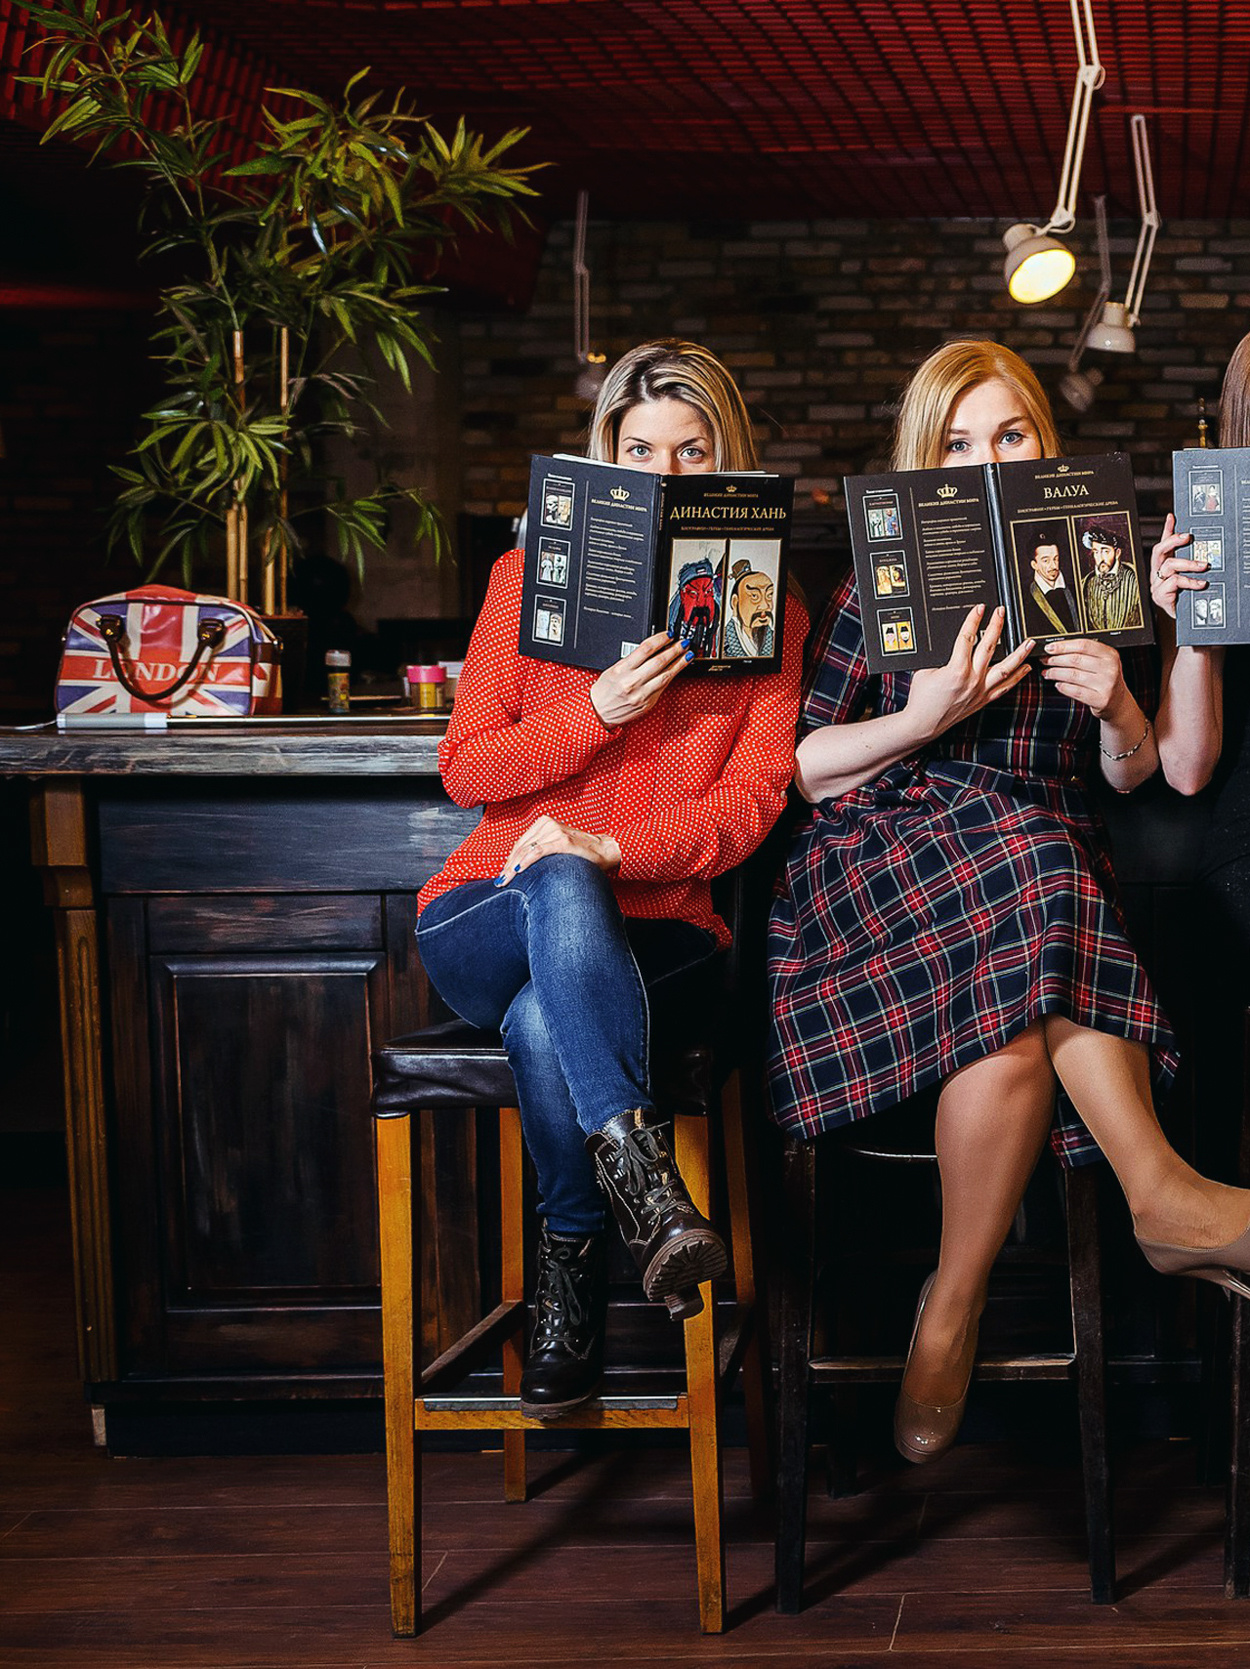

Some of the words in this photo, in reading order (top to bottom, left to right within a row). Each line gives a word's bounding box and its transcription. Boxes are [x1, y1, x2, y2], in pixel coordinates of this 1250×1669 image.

[1043, 484, 1090, 499] ВАЛУА
[670, 506, 749, 520] ДИНАСТИЯ
[751, 507, 787, 519] ХАНЬ
